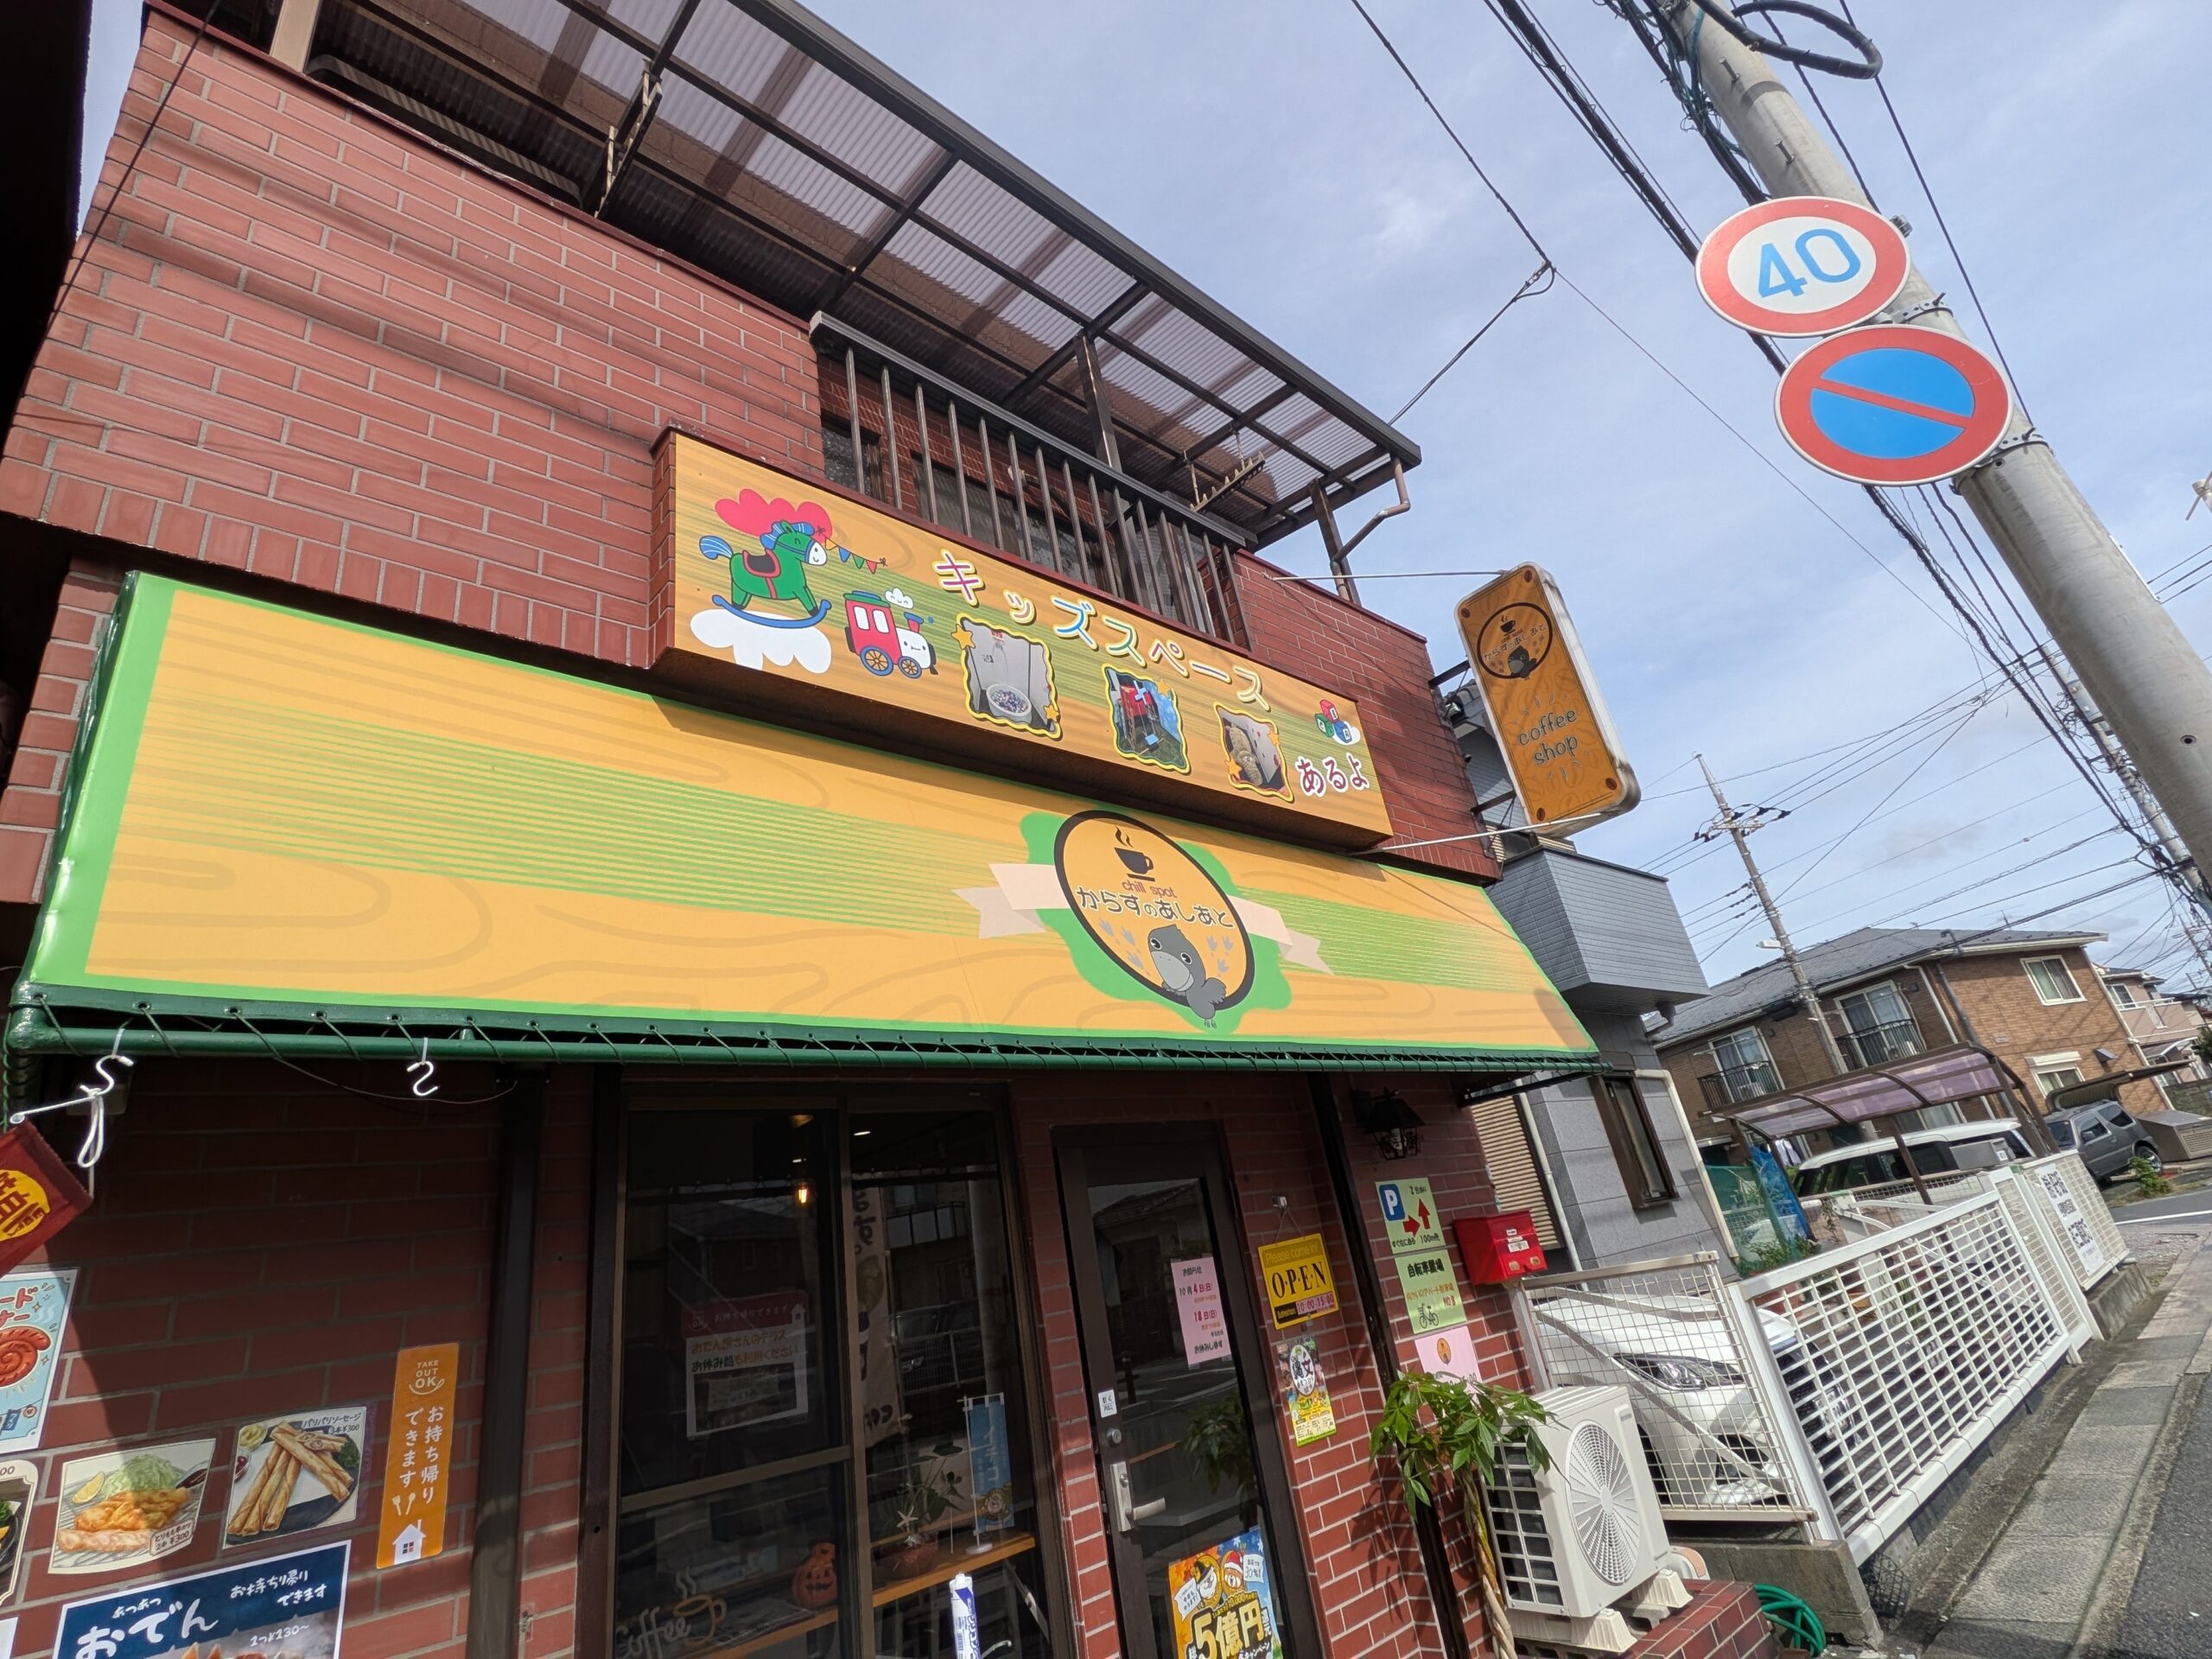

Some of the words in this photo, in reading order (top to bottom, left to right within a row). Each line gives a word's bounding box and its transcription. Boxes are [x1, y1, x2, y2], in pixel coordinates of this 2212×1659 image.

[1758, 228, 1861, 297] 40
[934, 550, 1270, 710] キッズスペース
[1517, 709, 1577, 746] coffee
[1534, 735, 1578, 765] shop
[1297, 754, 1368, 794] あるよ
[1122, 880, 1146, 894] chill
[1150, 886, 1177, 899] spot
[1077, 887, 1235, 929] からすのあしあと
[1384, 1189, 1398, 1216] P
[1265, 1250, 1290, 1265] Please
[416, 1359, 439, 1368] TAKE
[416, 1368, 439, 1377] OUT
[415, 1376, 436, 1389] OK
[303, 1412, 362, 1427] パリパリソーセージ
[399, 1408, 424, 1488] できます
[421, 1406, 444, 1504] お持ち帰り
[229, 1568, 308, 1599] お持ち帰り
[276, 1584, 327, 1607] できます
[111, 1598, 162, 1619] あつあつ
[75, 1598, 219, 1659] おでん
[1194, 1599, 1264, 1659] 5億円
